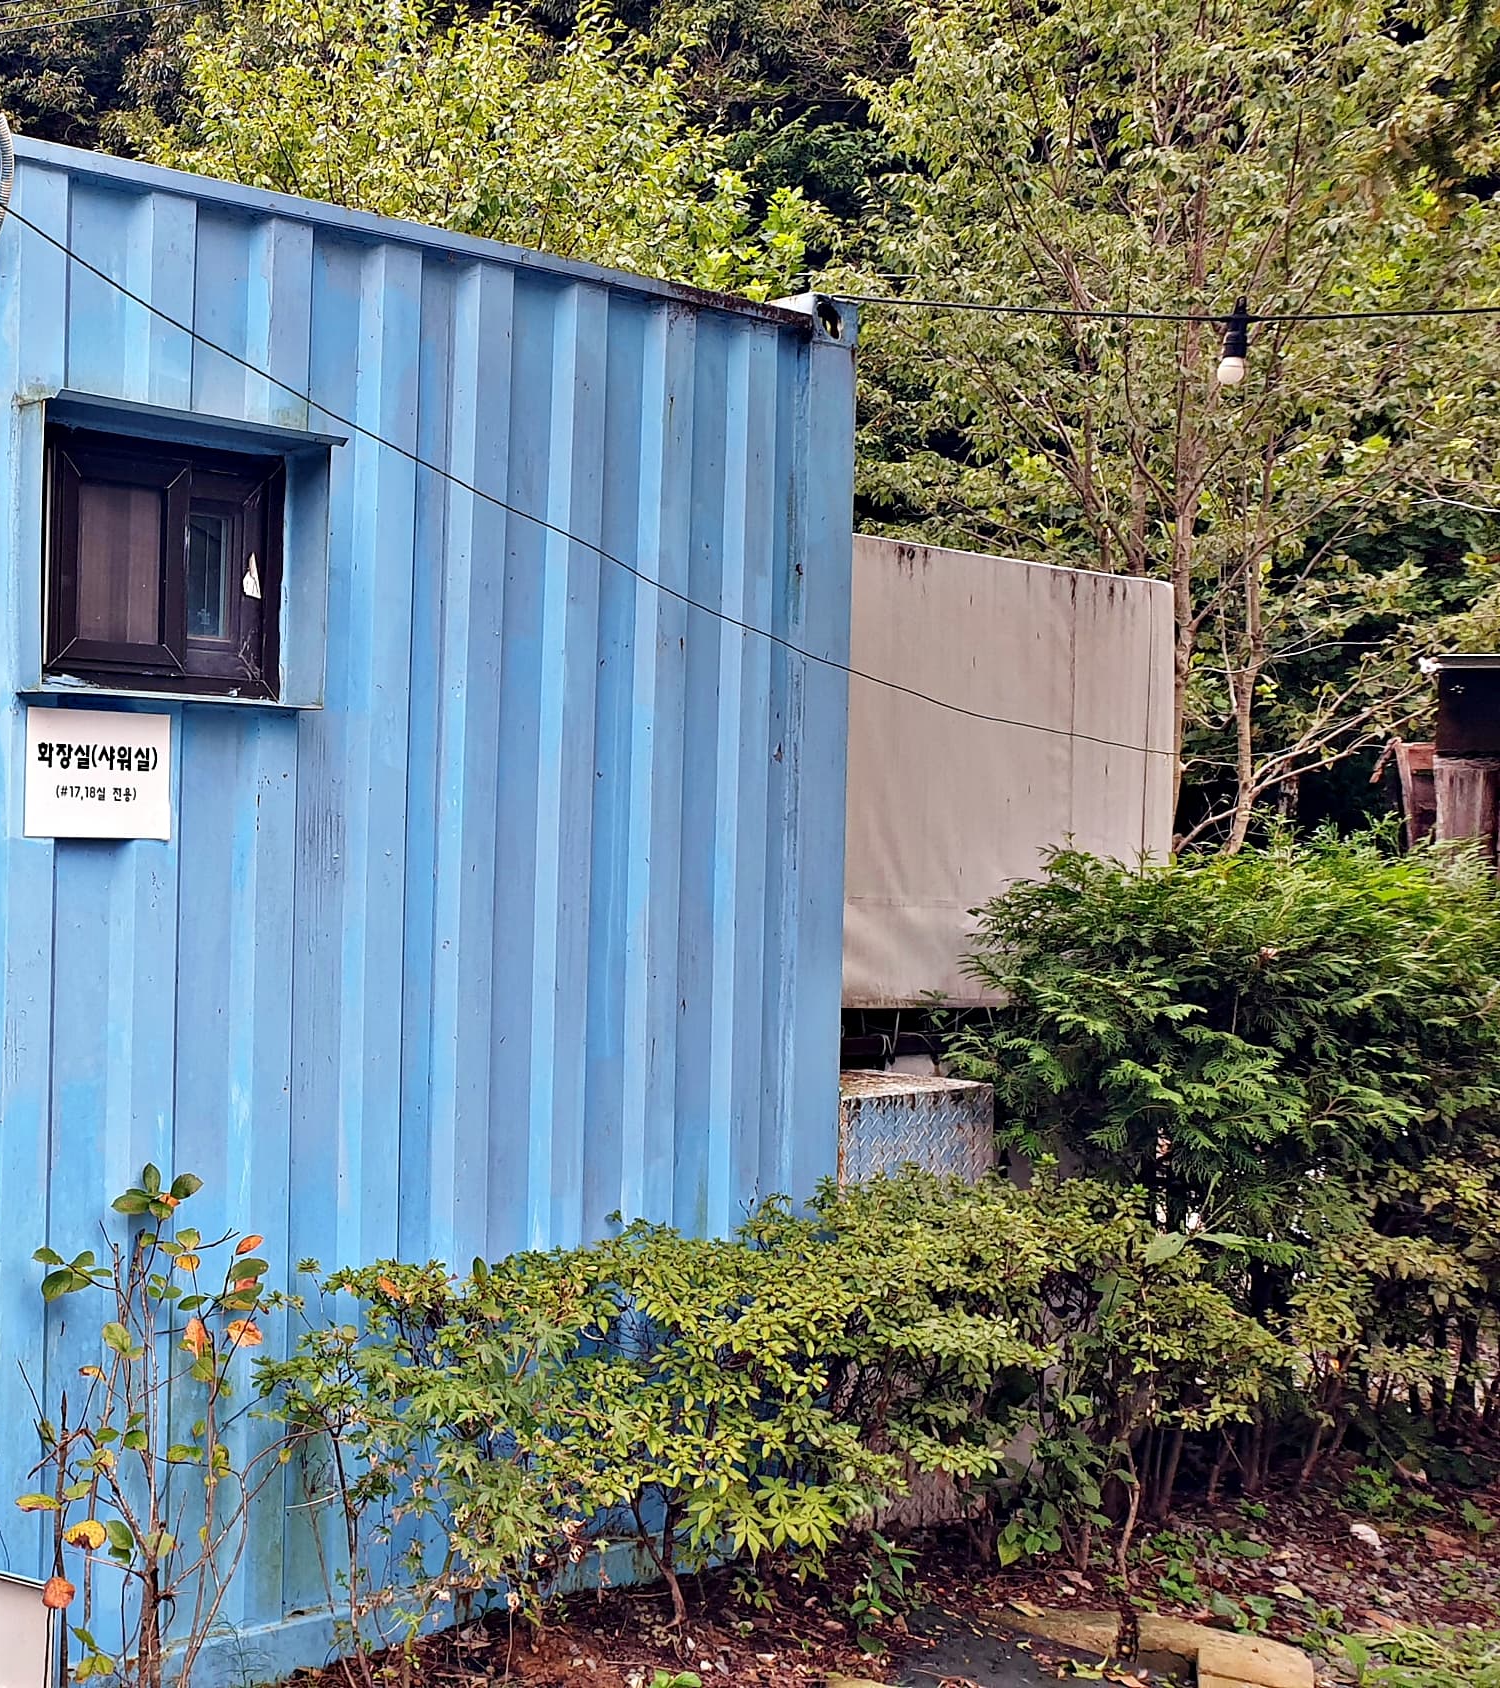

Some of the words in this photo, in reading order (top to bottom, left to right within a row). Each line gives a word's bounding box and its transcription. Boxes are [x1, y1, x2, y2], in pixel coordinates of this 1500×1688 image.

[37, 741, 158, 772] 화장실(샤워실)
[55, 784, 106, 801] (#17,18실
[112, 786, 137, 803] 전용)
